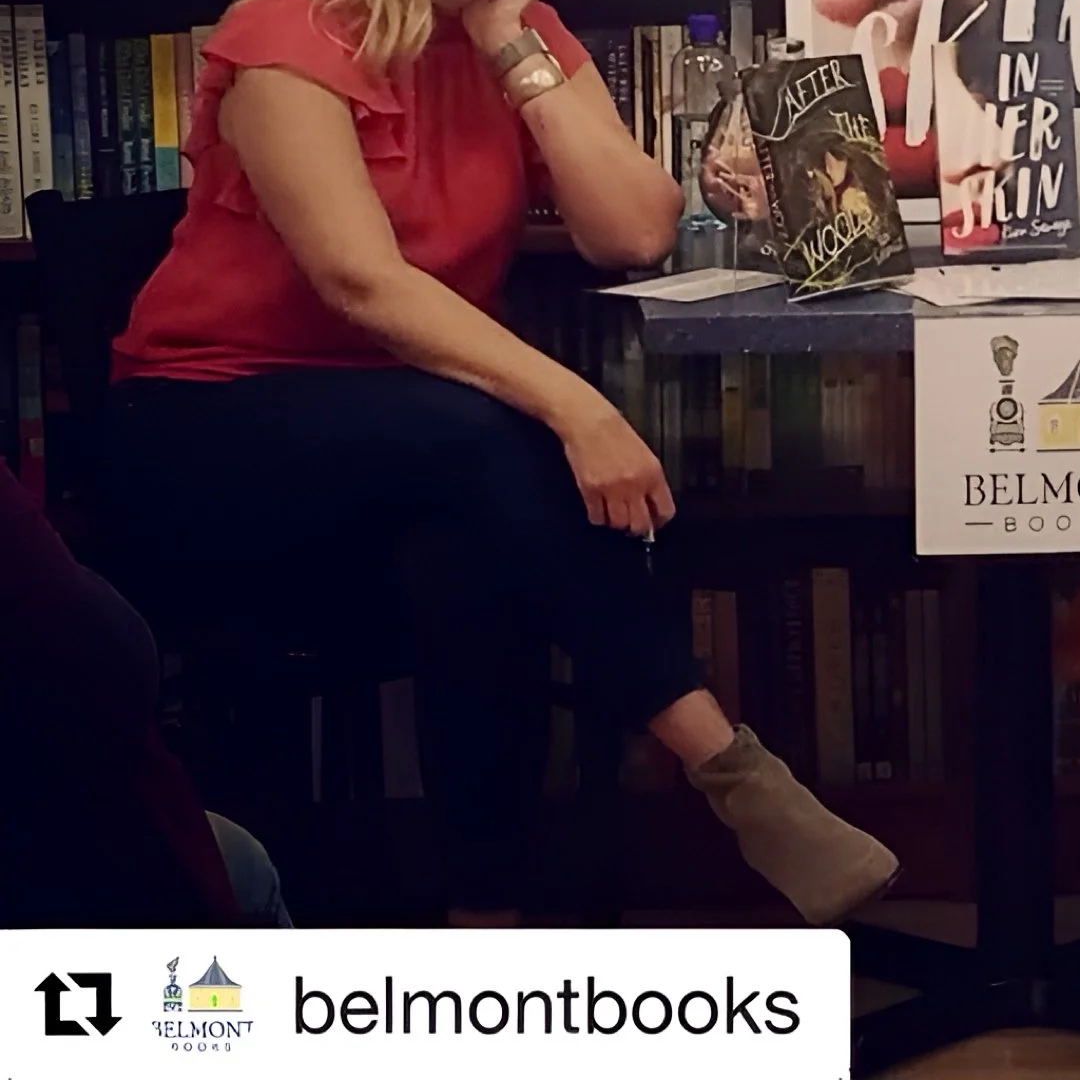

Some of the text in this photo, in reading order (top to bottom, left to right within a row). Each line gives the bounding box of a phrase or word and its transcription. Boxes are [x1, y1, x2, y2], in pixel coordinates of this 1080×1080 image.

[785, 59, 852, 119] AFTER
[998, 52, 1040, 102] IN
[829, 109, 871, 142] THE
[952, 162, 1064, 239] SKIN
